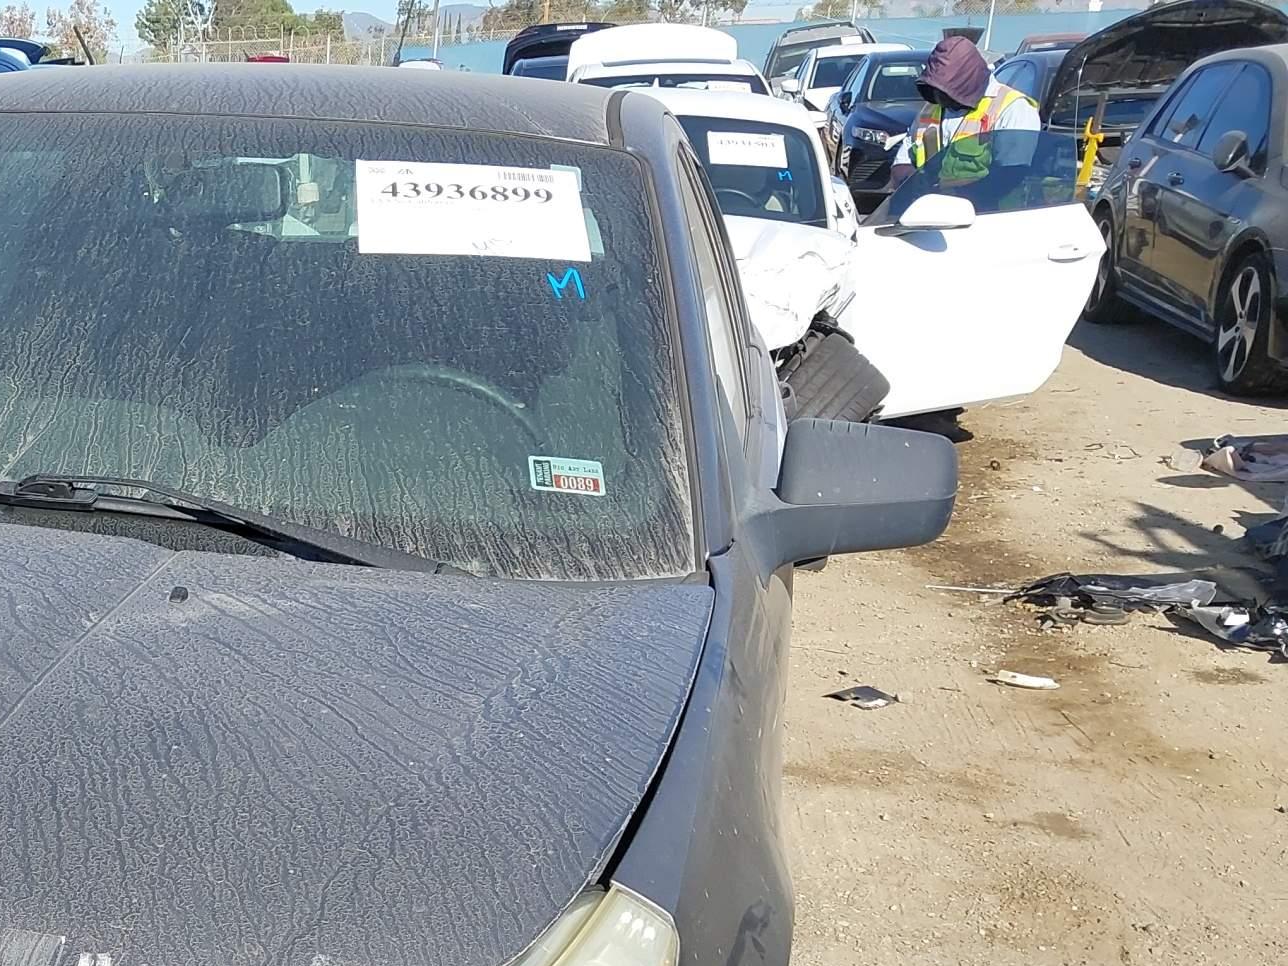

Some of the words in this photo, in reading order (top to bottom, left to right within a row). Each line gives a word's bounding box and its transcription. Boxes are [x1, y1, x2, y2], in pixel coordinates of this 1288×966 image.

[380, 181, 554, 204] 43936899
[546, 267, 586, 300] M
[560, 475, 594, 491] 0089
